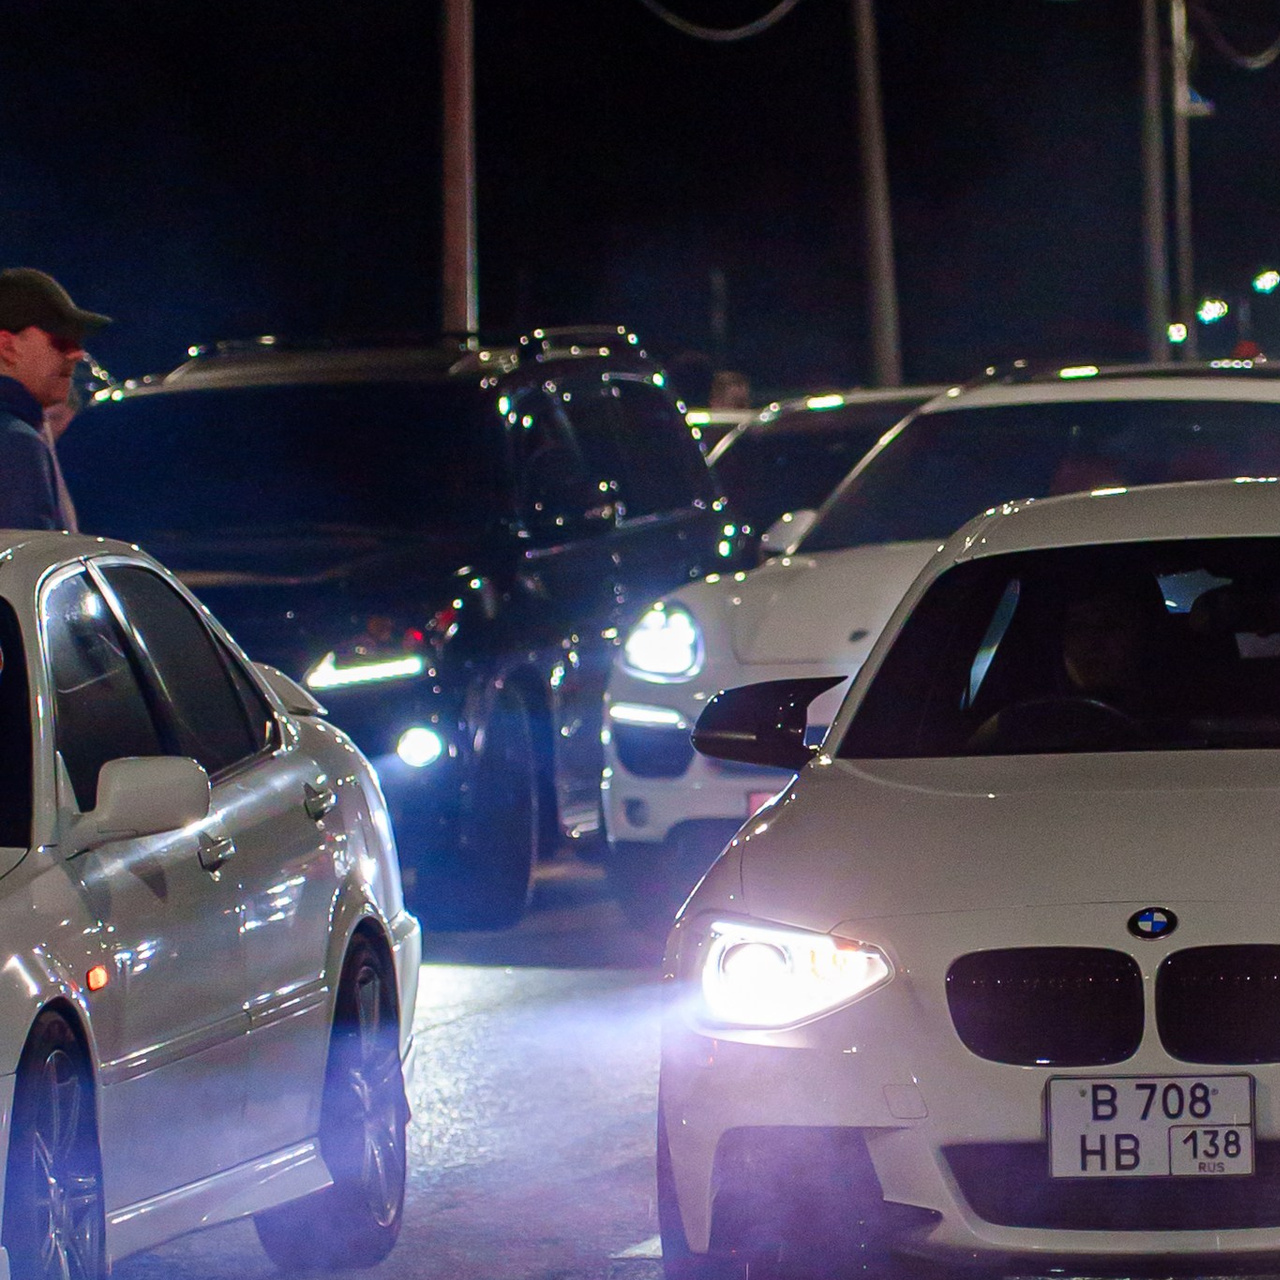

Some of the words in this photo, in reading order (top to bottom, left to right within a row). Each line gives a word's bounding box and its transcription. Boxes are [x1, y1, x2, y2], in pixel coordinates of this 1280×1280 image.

[1134, 1082, 1211, 1120] 708
[1182, 1129, 1241, 1159] 138
[1198, 1162, 1225, 1173] RUS
